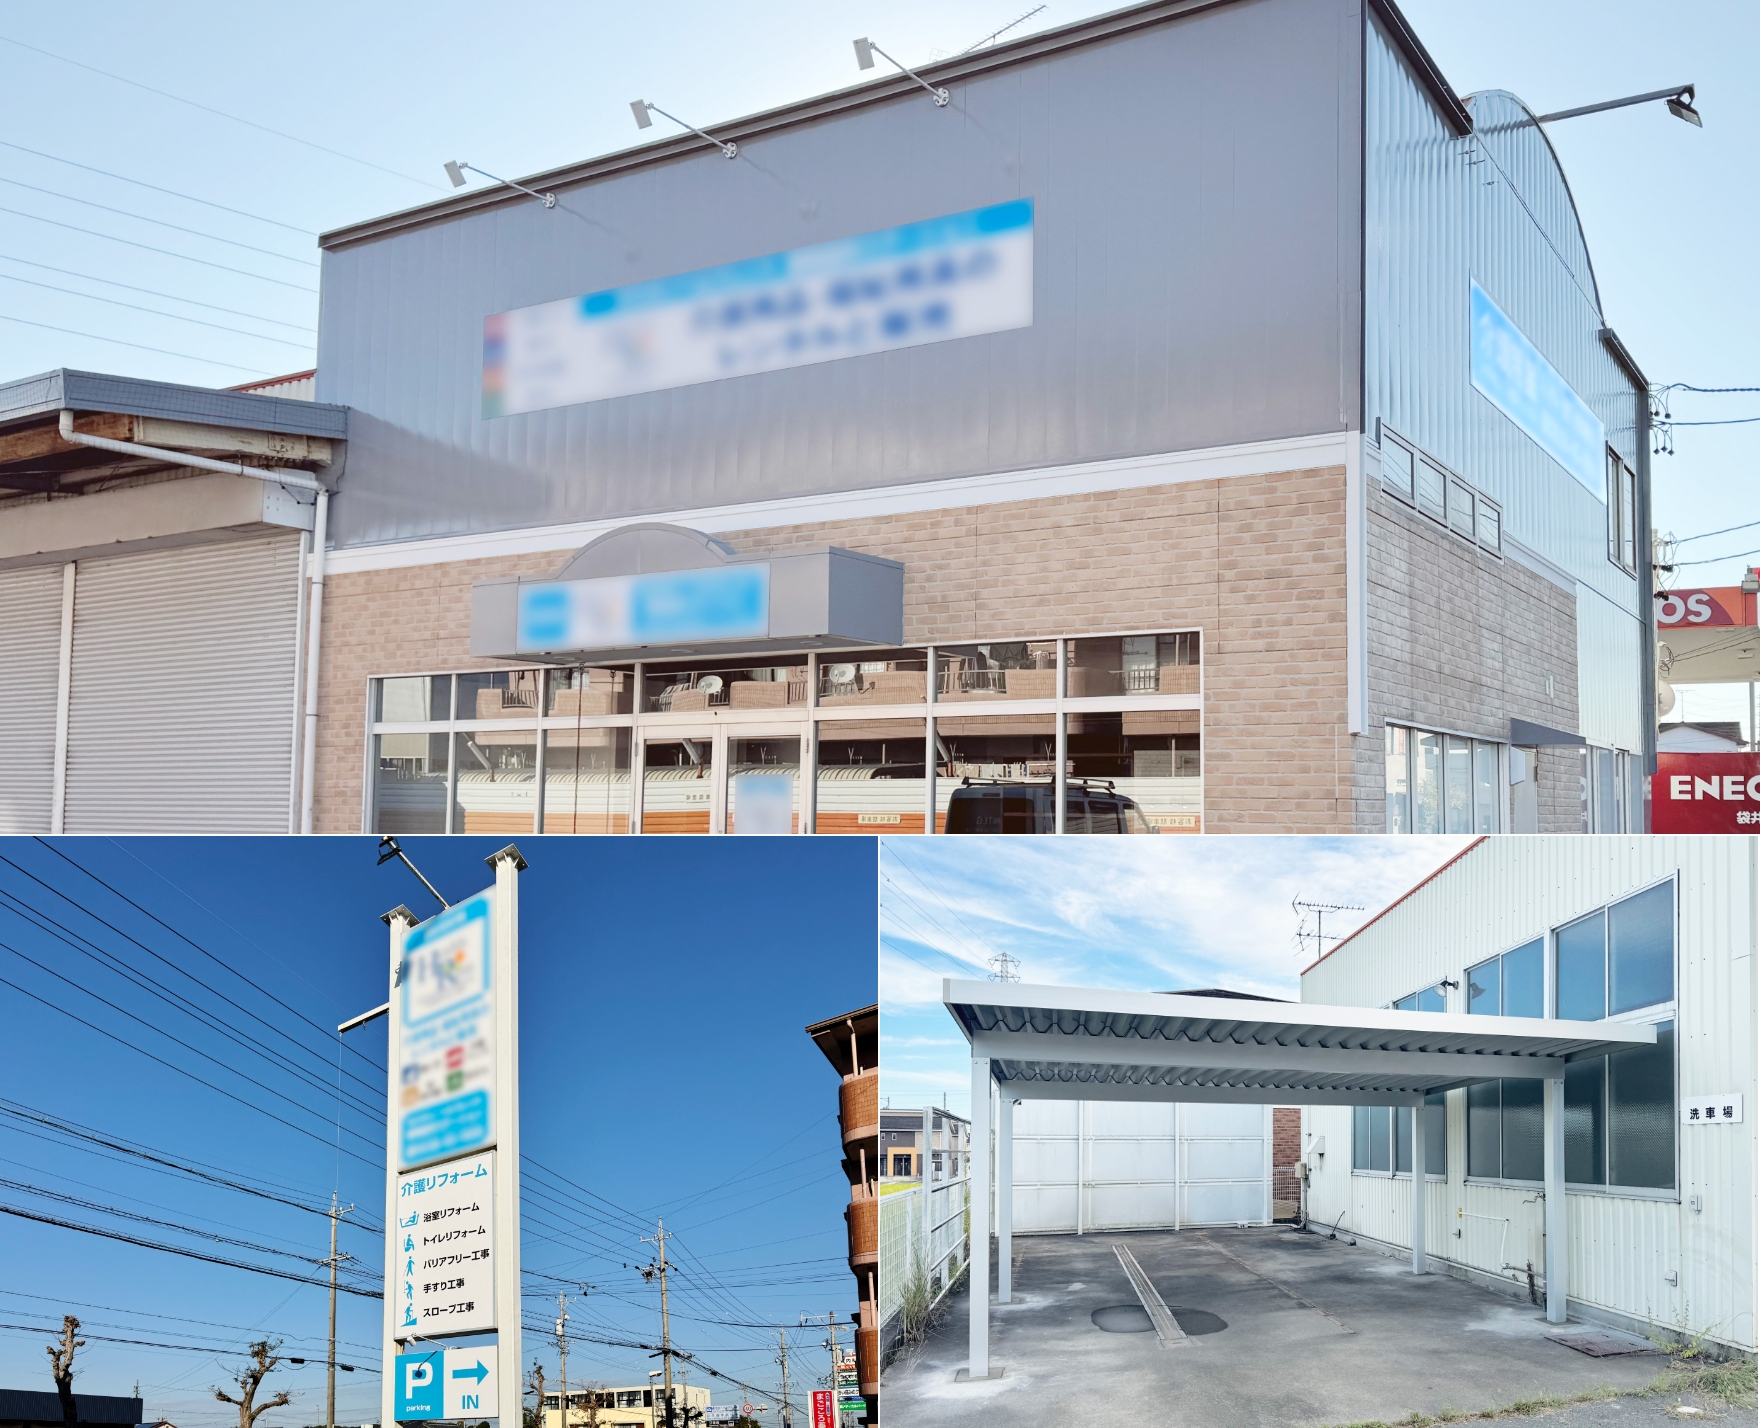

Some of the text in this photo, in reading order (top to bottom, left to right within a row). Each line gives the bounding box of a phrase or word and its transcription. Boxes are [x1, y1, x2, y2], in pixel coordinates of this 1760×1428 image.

[1689, 1106, 1733, 1120] 洗車場
[401, 1163, 488, 1197] 介護リフォーム
[423, 1202, 480, 1223] 浴室リフォーム
[423, 1225, 486, 1246] トイレリフォーム
[423, 1248, 490, 1269] バリアフリー工事
[423, 1277, 465, 1294] 手すり工事
[423, 1301, 475, 1318] スロープ工事
[405, 1362, 434, 1400] P
[406, 1404, 431, 1413] parking
[462, 1394, 479, 1410] IN
